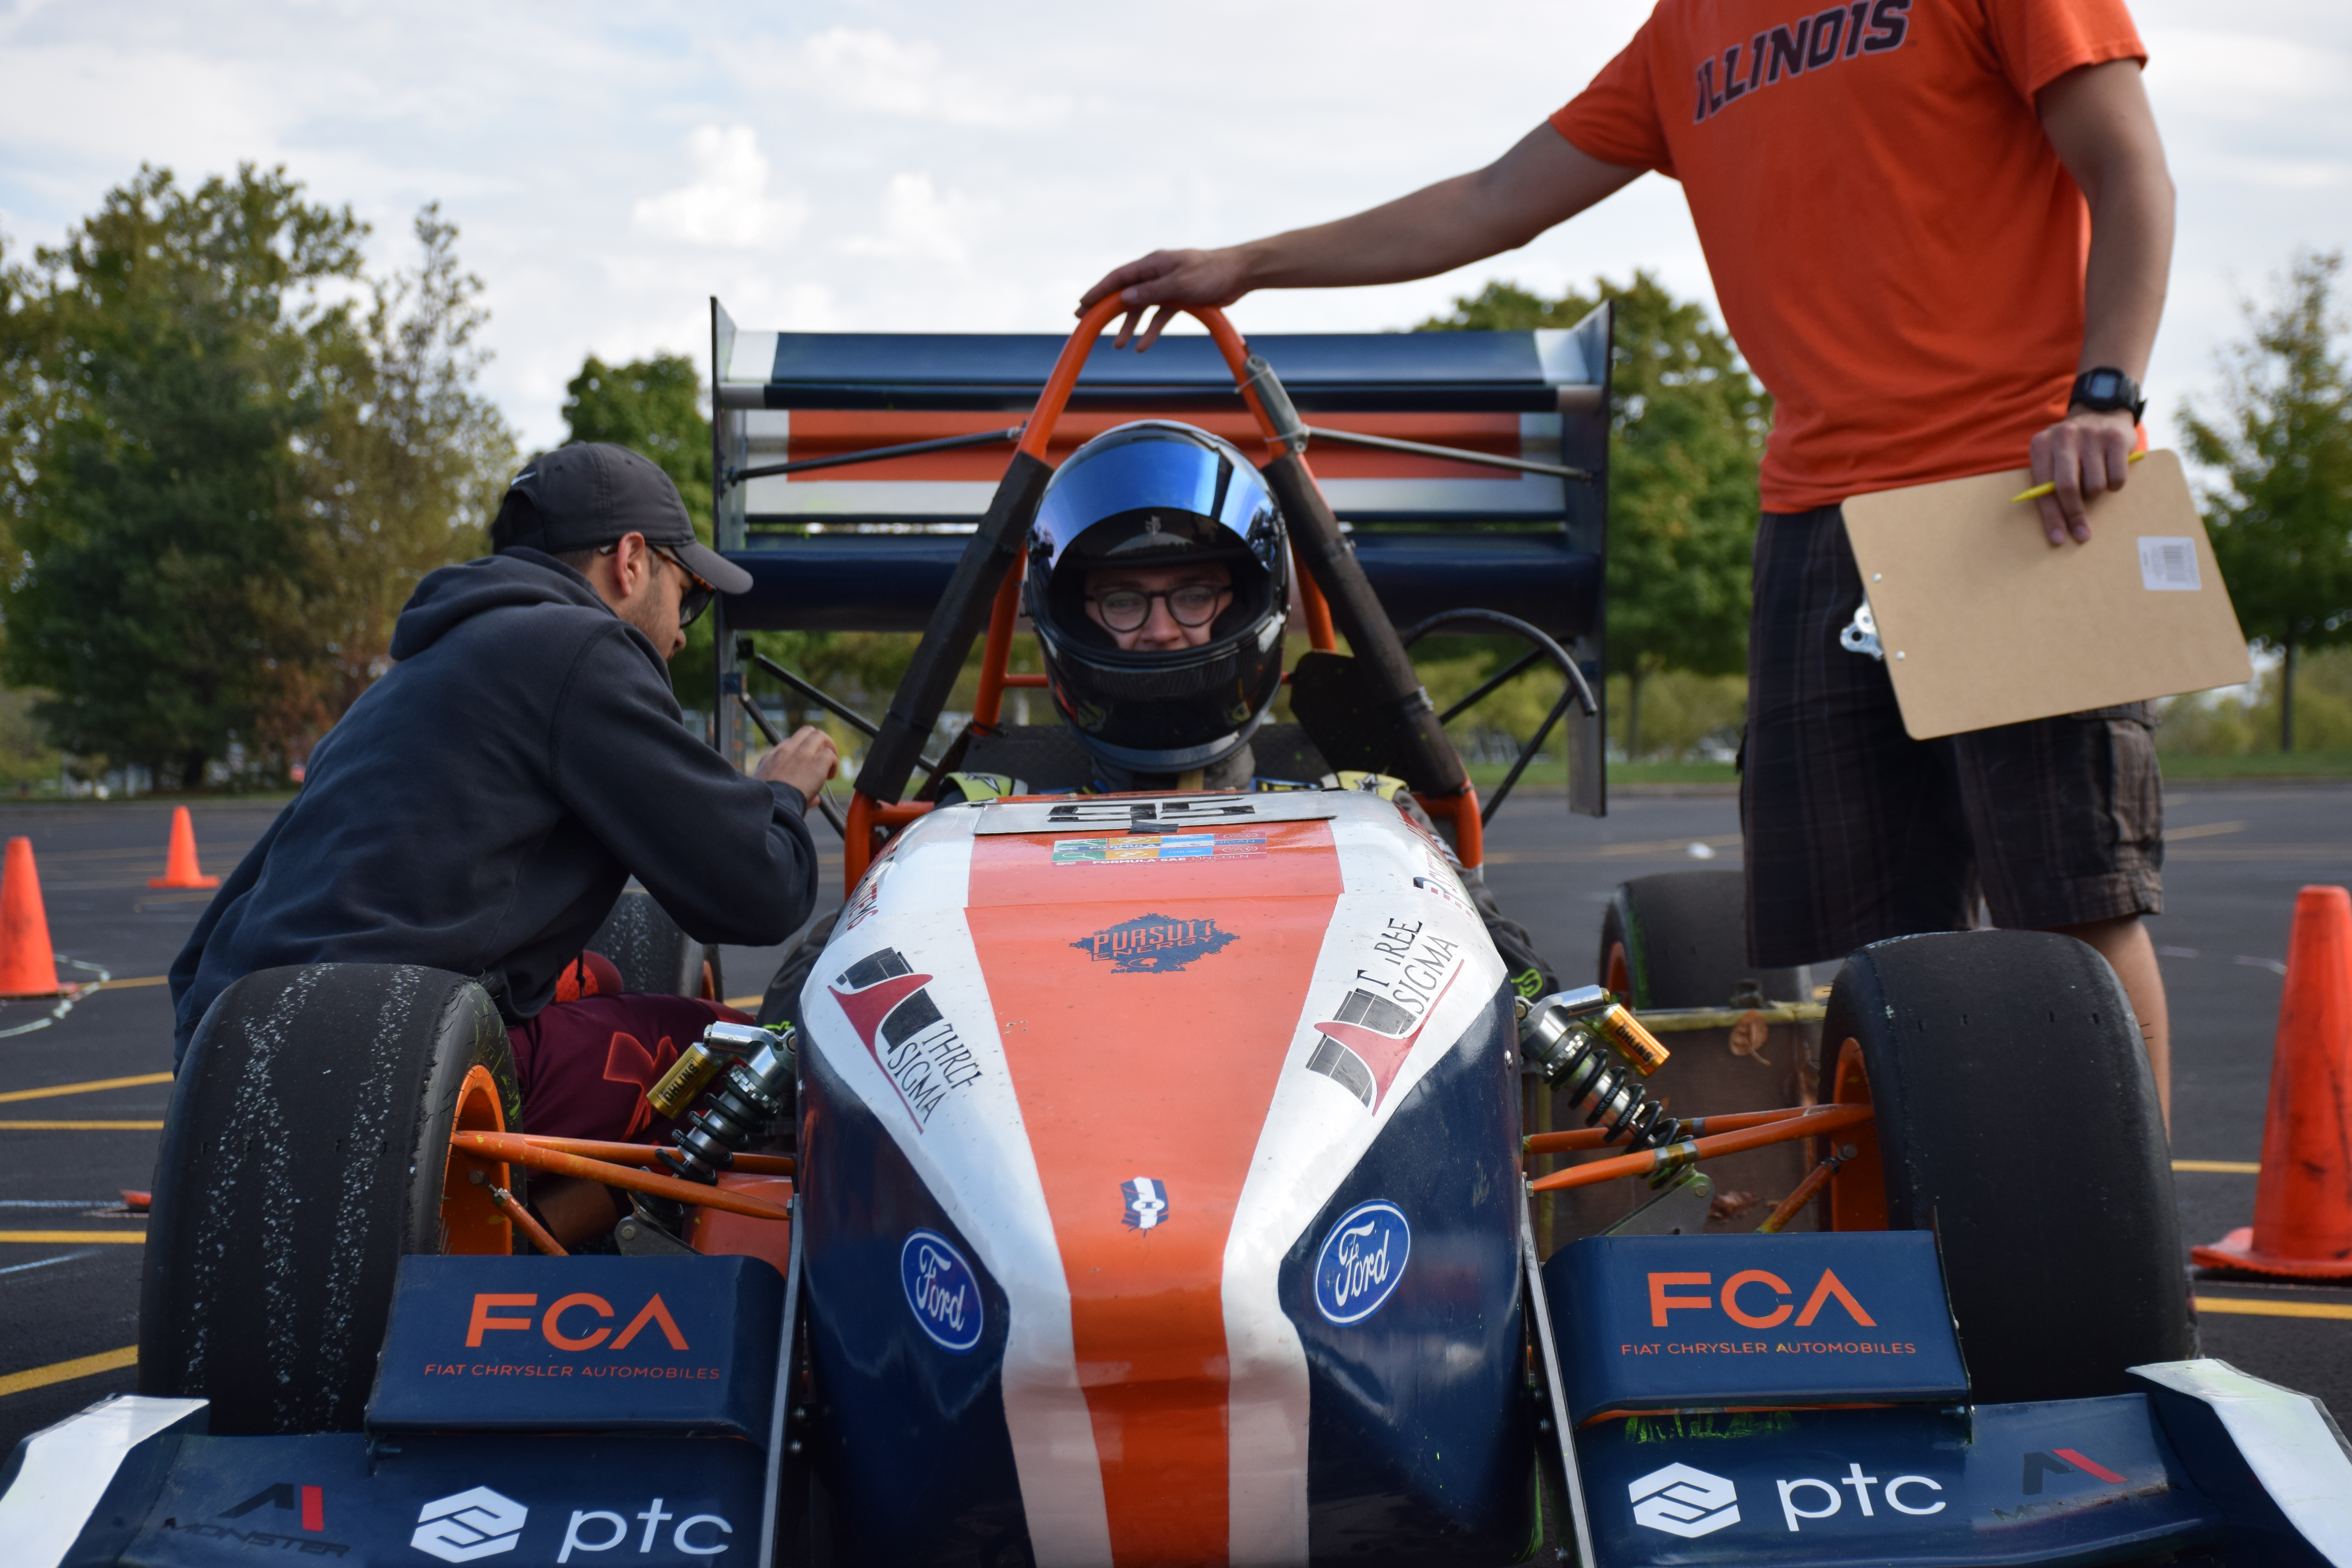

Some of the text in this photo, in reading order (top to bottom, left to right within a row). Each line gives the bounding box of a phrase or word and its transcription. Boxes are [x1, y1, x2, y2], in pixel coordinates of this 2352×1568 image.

[1693, 0, 1914, 125] ILLINOIS
[1093, 918, 1216, 954] PURSUIT
[1093, 935, 1214, 961] ENERGY
[1392, 935, 1459, 1014] SIGMA
[887, 1042, 950, 1124] SIGMA
[916, 1244, 965, 1332] Ford
[1335, 1220, 1390, 1307] Ford
[465, 1292, 690, 1352] FCA
[1648, 1267, 1878, 1329] FCA
[424, 1363, 720, 1380] FIAT CHRYSLER AUTOMOBILES
[1621, 1341, 1916, 1356] FIAT CHRYSLER AUTOMOBILES
[1776, 1462, 1947, 1532] ptc
[161, 1516, 351, 1559] MONSTER
[556, 1497, 733, 1563] ptc
